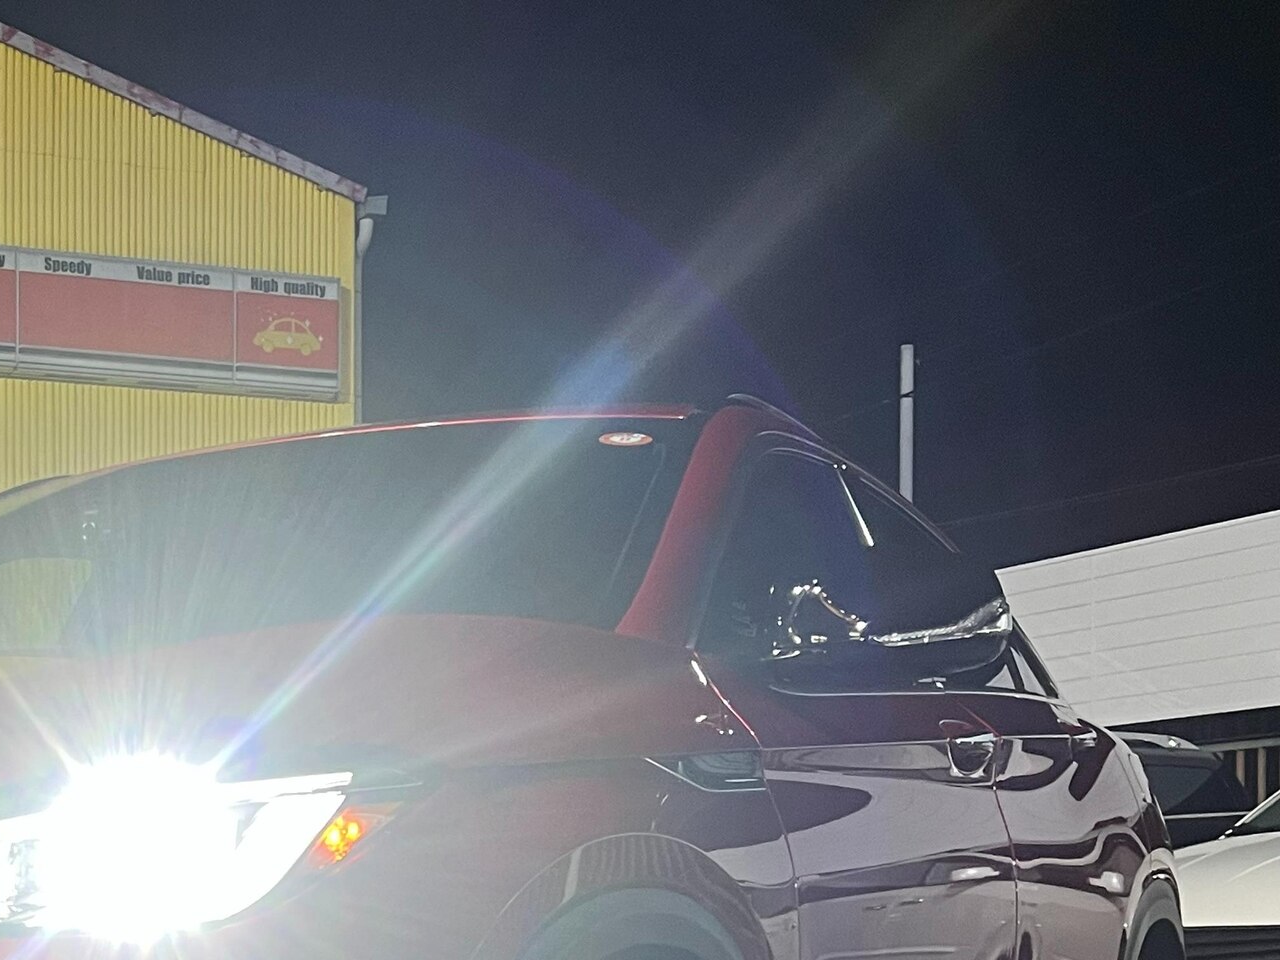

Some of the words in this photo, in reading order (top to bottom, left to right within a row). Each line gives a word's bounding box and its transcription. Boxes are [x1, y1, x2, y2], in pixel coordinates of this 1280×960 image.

[44, 257, 92, 276] Speedy
[136, 265, 172, 283] Value
[177, 271, 210, 286] price
[250, 276, 279, 293] High
[283, 281, 326, 298] quality
